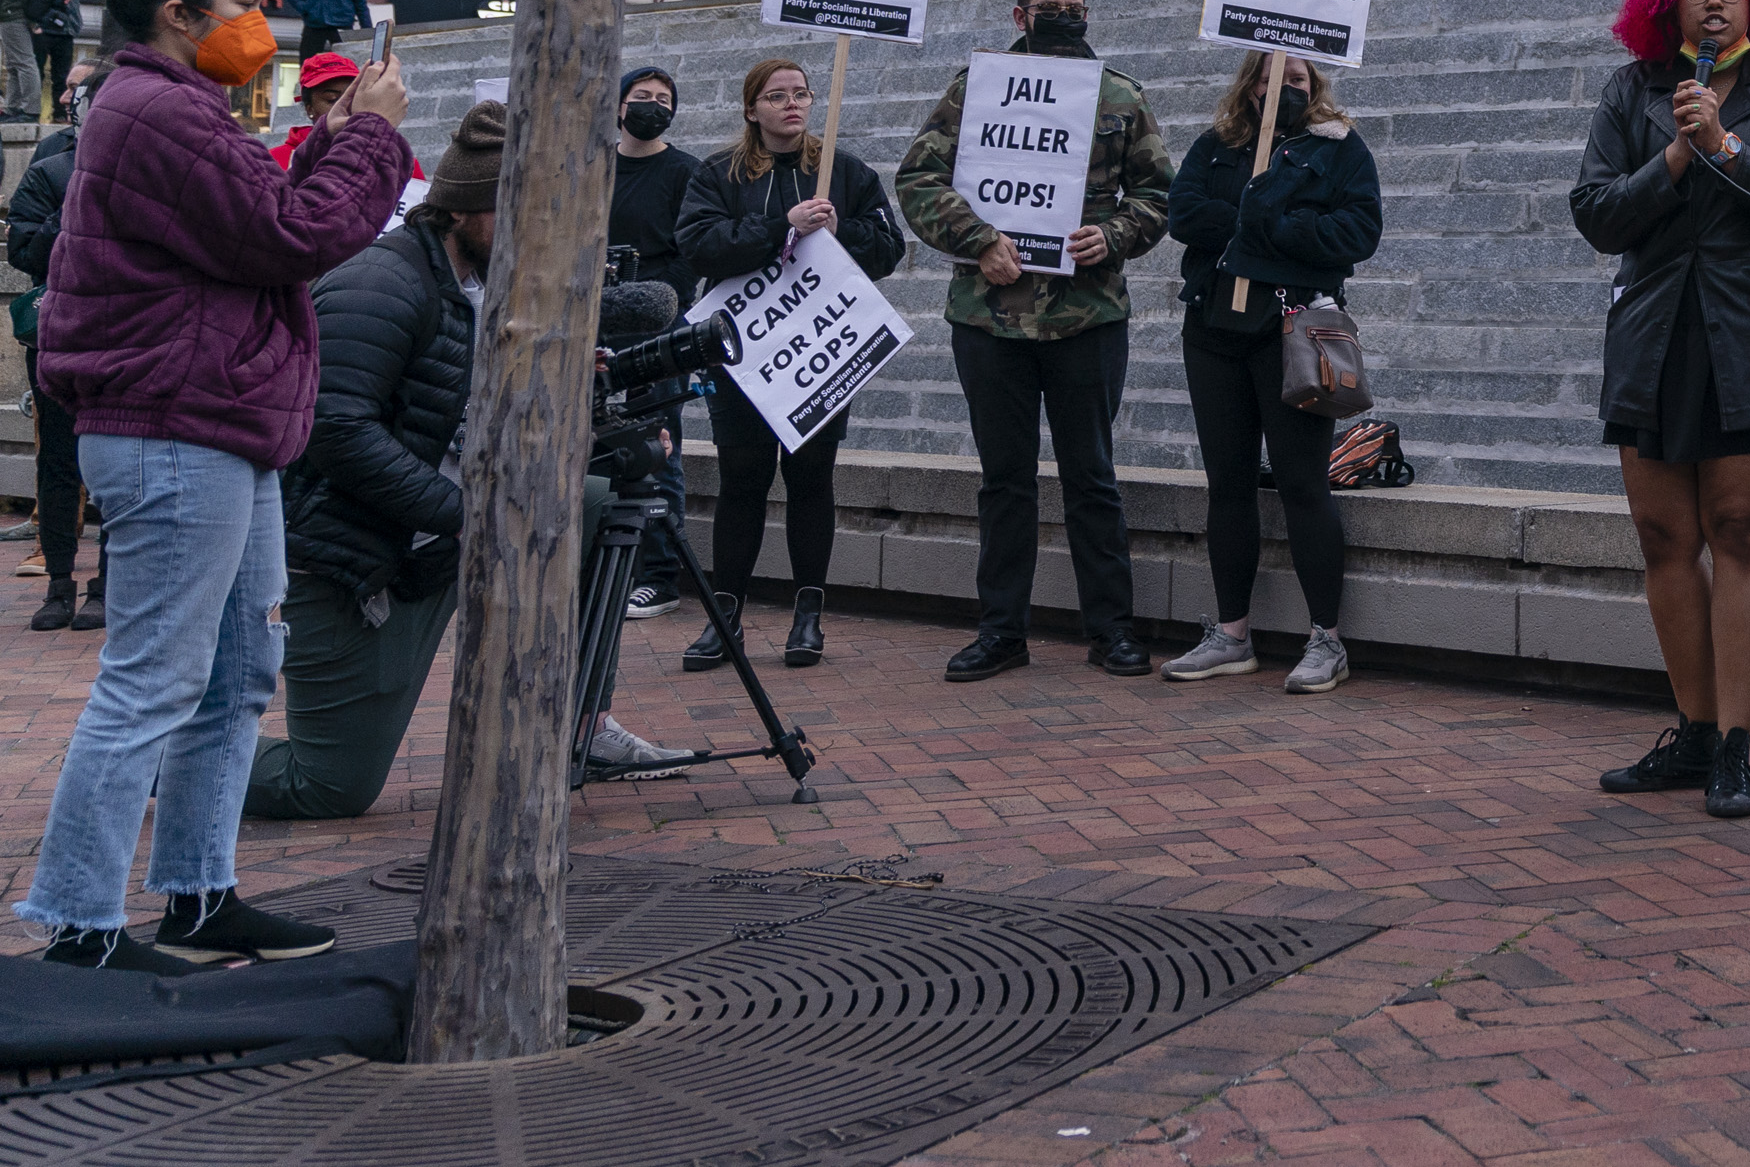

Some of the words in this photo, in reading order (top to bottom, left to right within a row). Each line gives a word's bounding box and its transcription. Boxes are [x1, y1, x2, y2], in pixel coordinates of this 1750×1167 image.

[809, 0, 821, 8] for
[822, 1, 860, 14] Socialism
[862, 7, 867, 15] &
[869, 8, 907, 20] Liberation
[815, 13, 876, 29] @PSLAtlanta
[1225, 10, 1247, 23] Party
[1248, 14, 1260, 24] for
[1262, 16, 1300, 30] Socialism
[1301, 23, 1306, 31] &
[1308, 25, 1347, 39] Liberation
[1254, 28, 1315, 47] @PSLAtlanta
[1001, 77, 1056, 107] JAIL
[980, 123, 1069, 154] KILLER
[978, 179, 1055, 209] COPS!
[1019, 239, 1025, 247] &
[1026, 238, 1060, 251] Liberation
[746, 267, 821, 341] CAMS
[759, 334, 811, 384] FOR
[813, 291, 857, 338] ALL
[794, 324, 858, 388] COPS
[792, 406, 813, 424] Party
[811, 395, 822, 407] for
[821, 366, 853, 398] Socialism
[857, 330, 888, 363] Liberation
[824, 361, 872, 410] @PSLAtlanta
